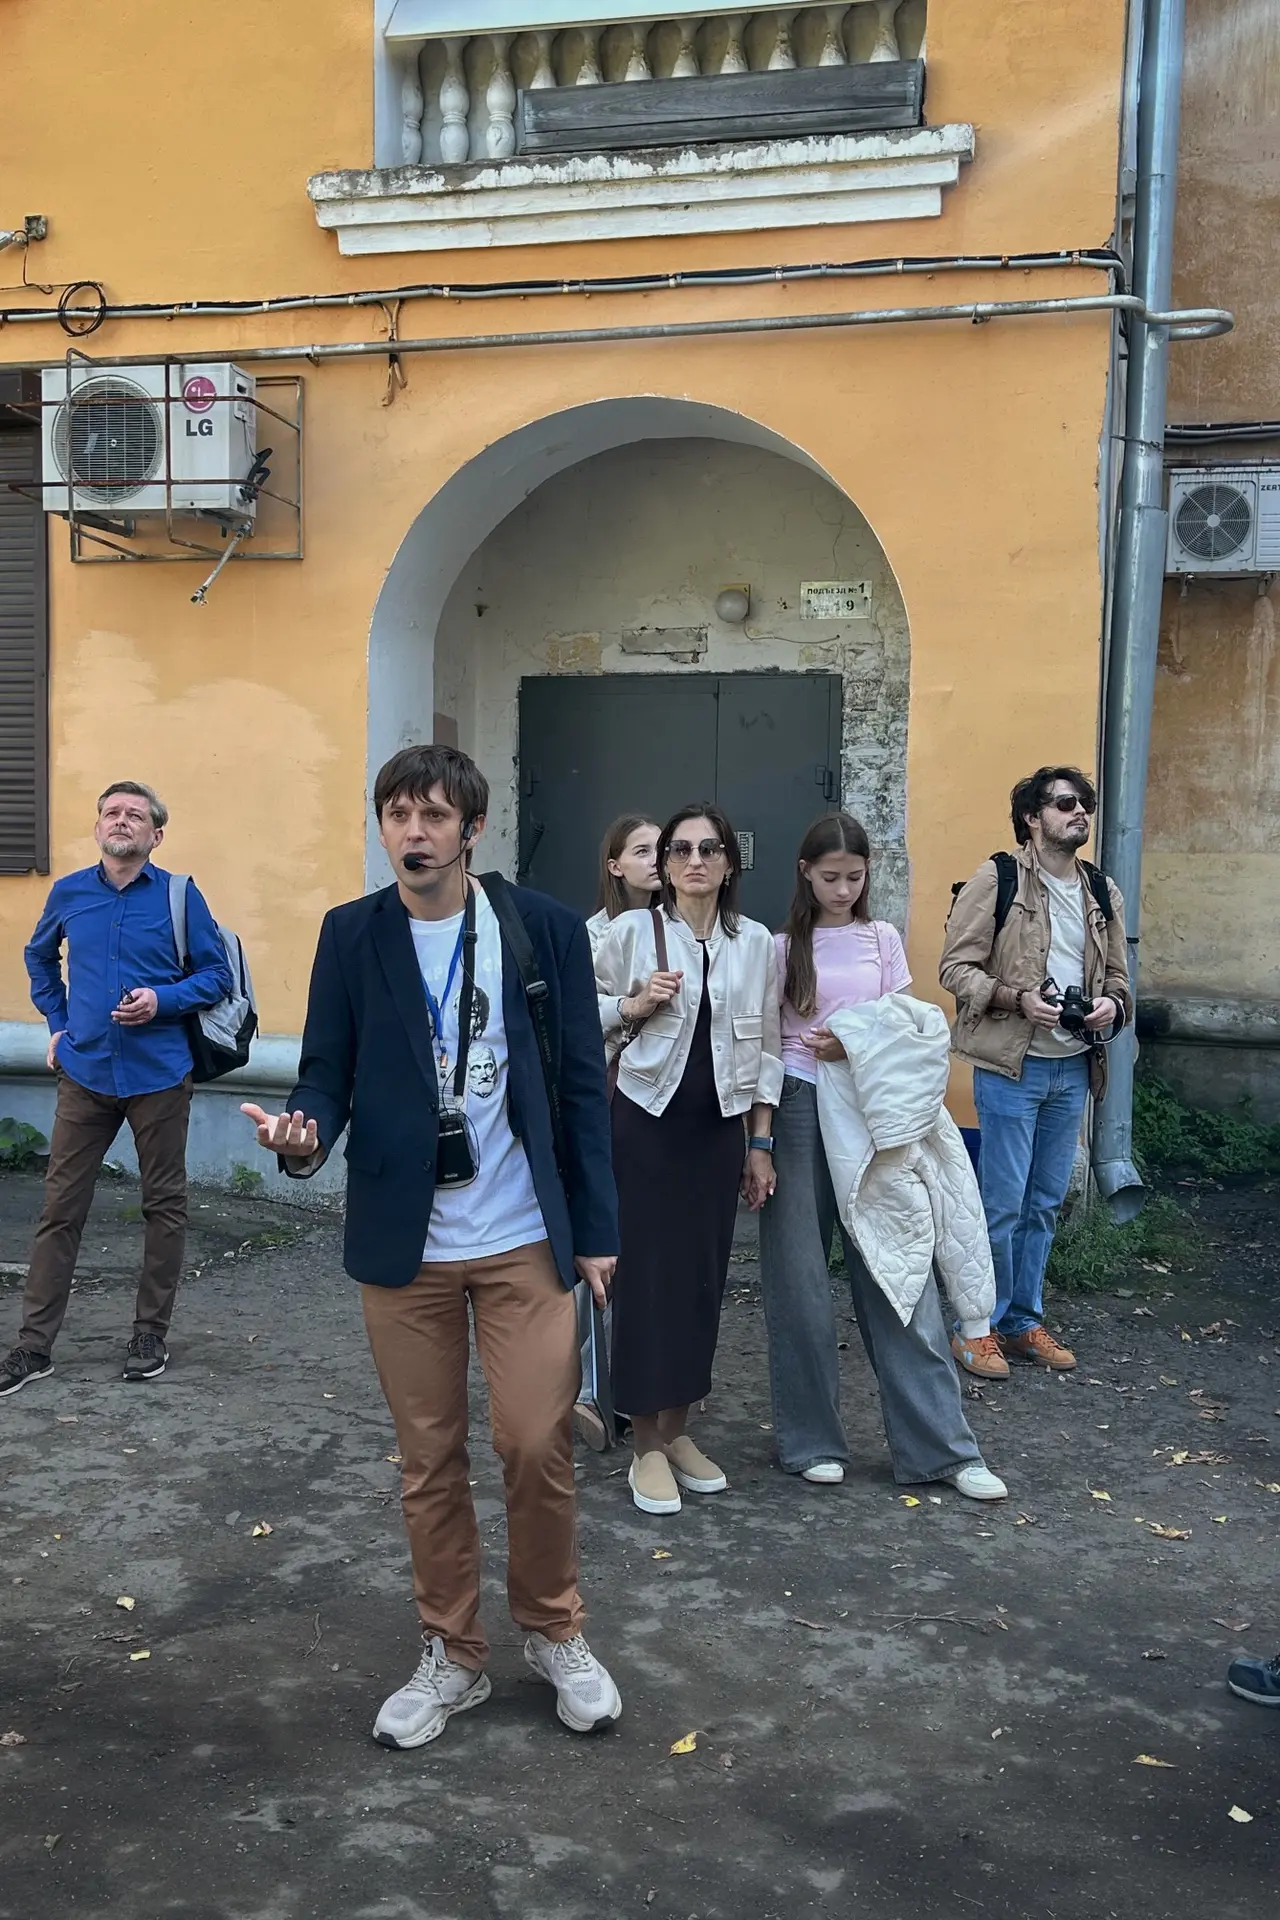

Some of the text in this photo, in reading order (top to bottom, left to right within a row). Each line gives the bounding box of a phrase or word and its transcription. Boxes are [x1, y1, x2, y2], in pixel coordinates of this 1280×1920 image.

[186, 418, 213, 436] LG
[807, 587, 846, 595] ПОДЪЕЗД
[858, 582, 865, 594] 1
[846, 600, 855, 611] 9
